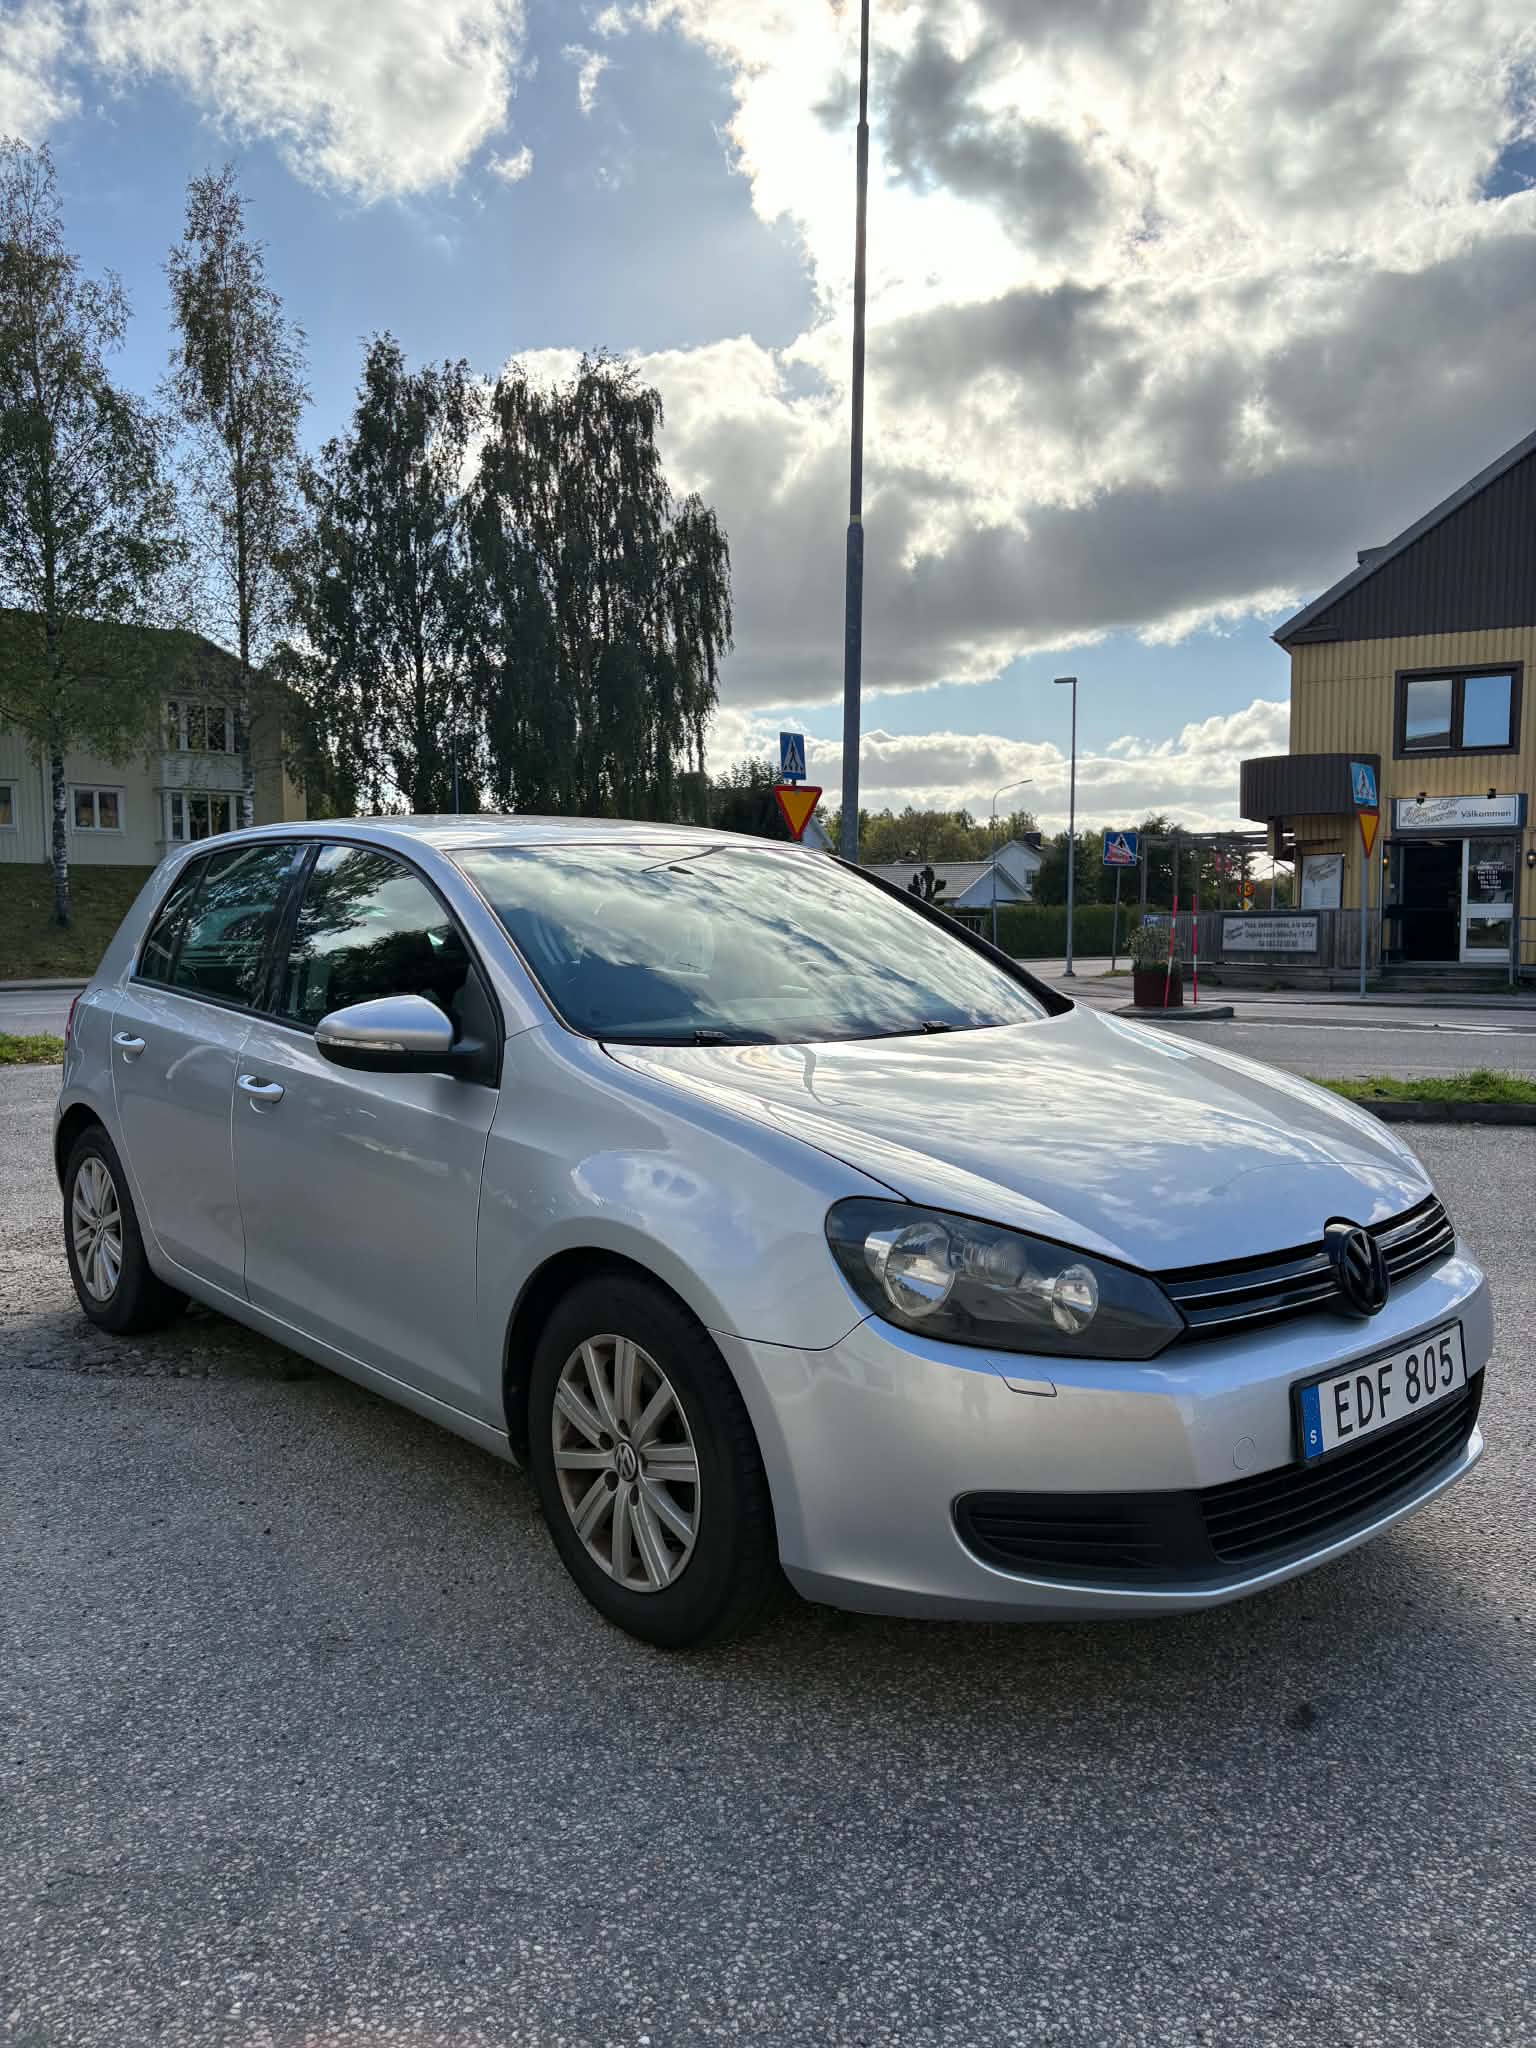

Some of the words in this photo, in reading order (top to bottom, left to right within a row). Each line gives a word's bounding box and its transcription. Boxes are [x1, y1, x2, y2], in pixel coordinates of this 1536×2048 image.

[1461, 808, 1512, 818] Välkommen
[1333, 1363, 1393, 1437] EDF
[1405, 1336, 1454, 1405] 805
[1310, 1429, 1318, 1445] S
